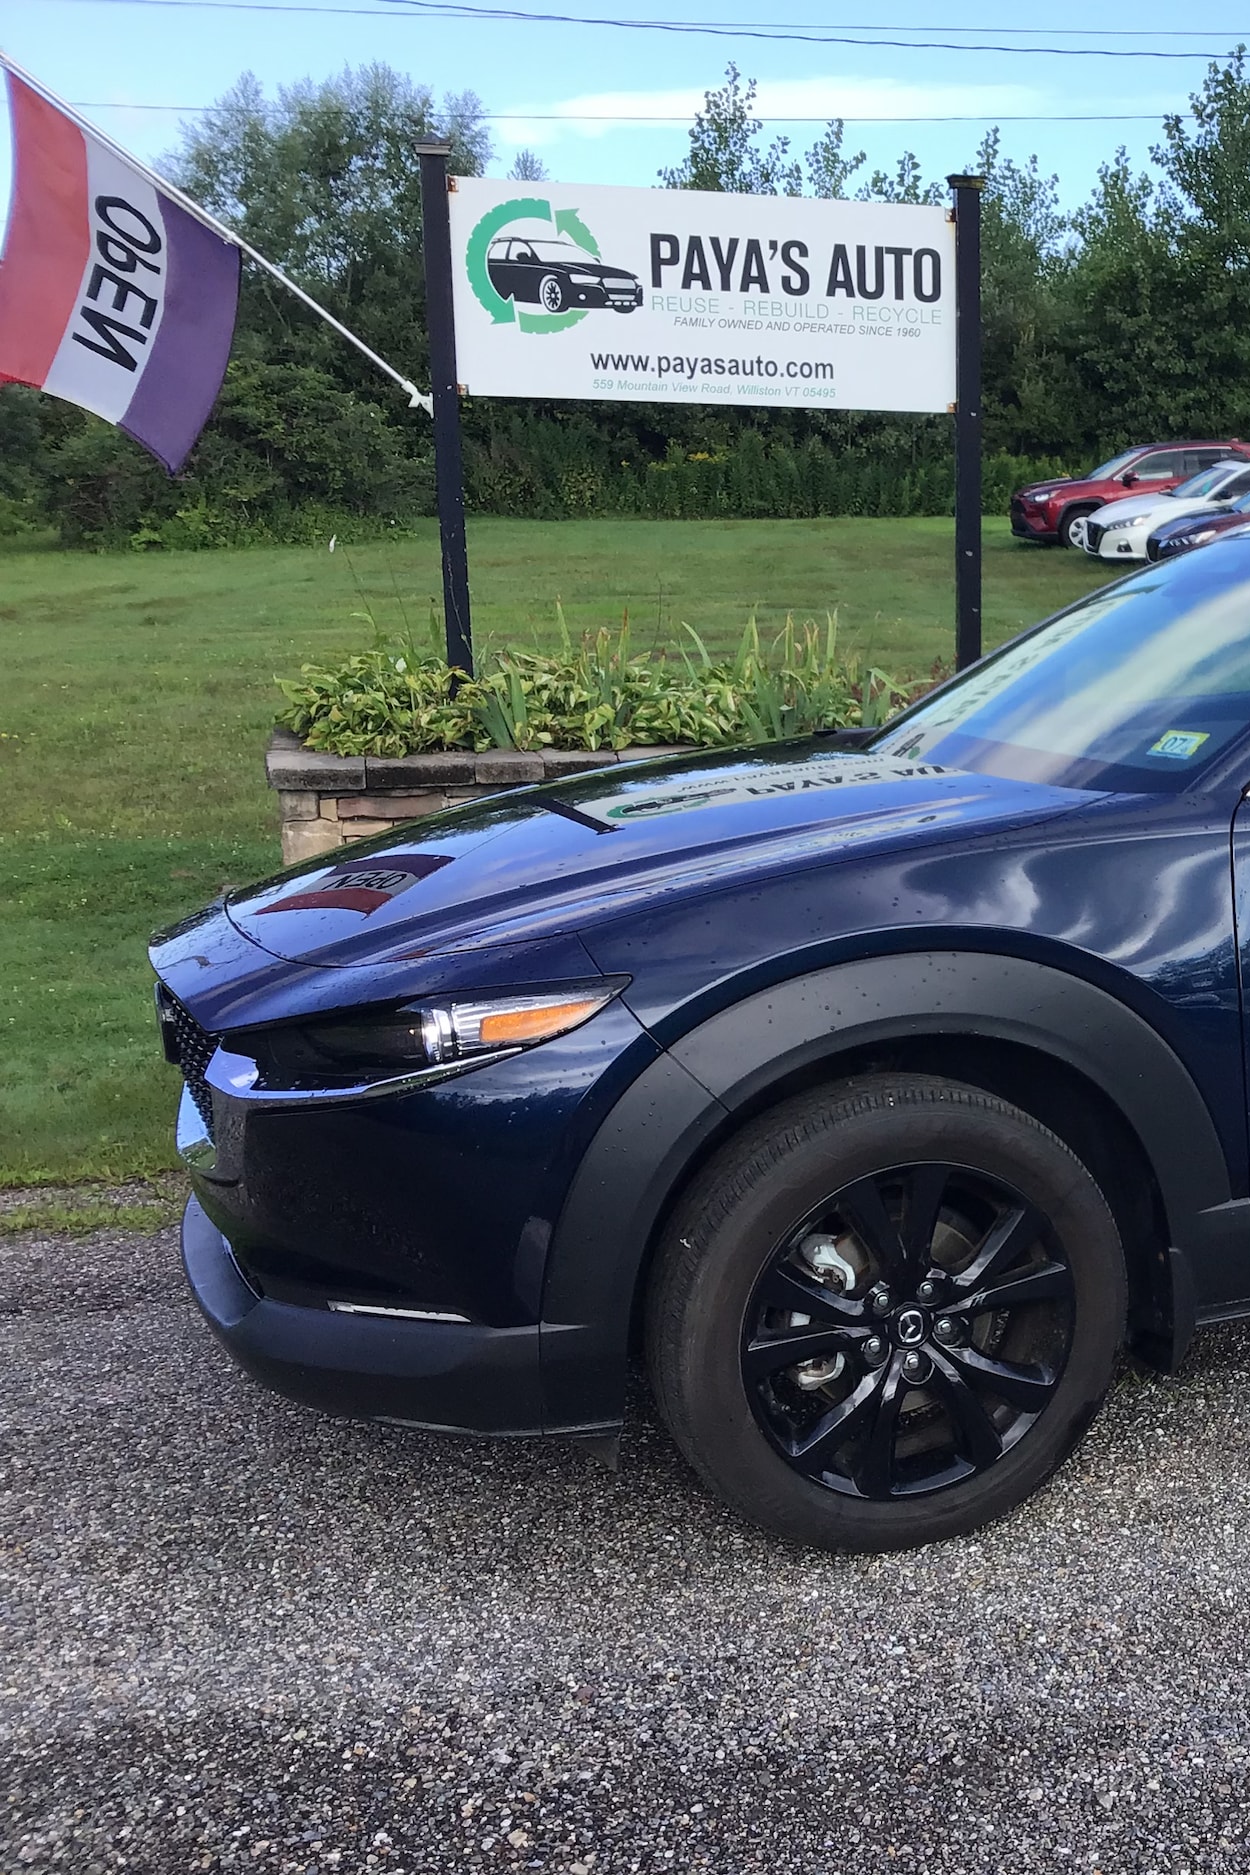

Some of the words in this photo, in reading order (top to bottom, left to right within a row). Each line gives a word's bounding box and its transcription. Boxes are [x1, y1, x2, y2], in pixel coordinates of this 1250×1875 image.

[650, 232, 810, 296] PAYA'S
[826, 243, 942, 303] AUTO
[651, 295, 720, 314] REUSE
[743, 299, 829, 319] REBUILD
[852, 305, 942, 325] RECYCLE
[673, 316, 716, 329] FAMILY
[718, 318, 763, 330] OWNED
[765, 320, 790, 332] AND
[793, 321, 855, 335] OPERATED
[858, 325, 893, 337] SINCE
[896, 327, 921, 338] 1960
[590, 352, 834, 380] www.payasauto.com
[592, 379, 614, 390] 559
[617, 380, 668, 392] Mountain
[672, 382, 698, 393] View
[700, 383, 733, 395] Road,
[736, 384, 781, 396] Williston
[784, 386, 801, 397] VT
[803, 387, 836, 398] 05495
